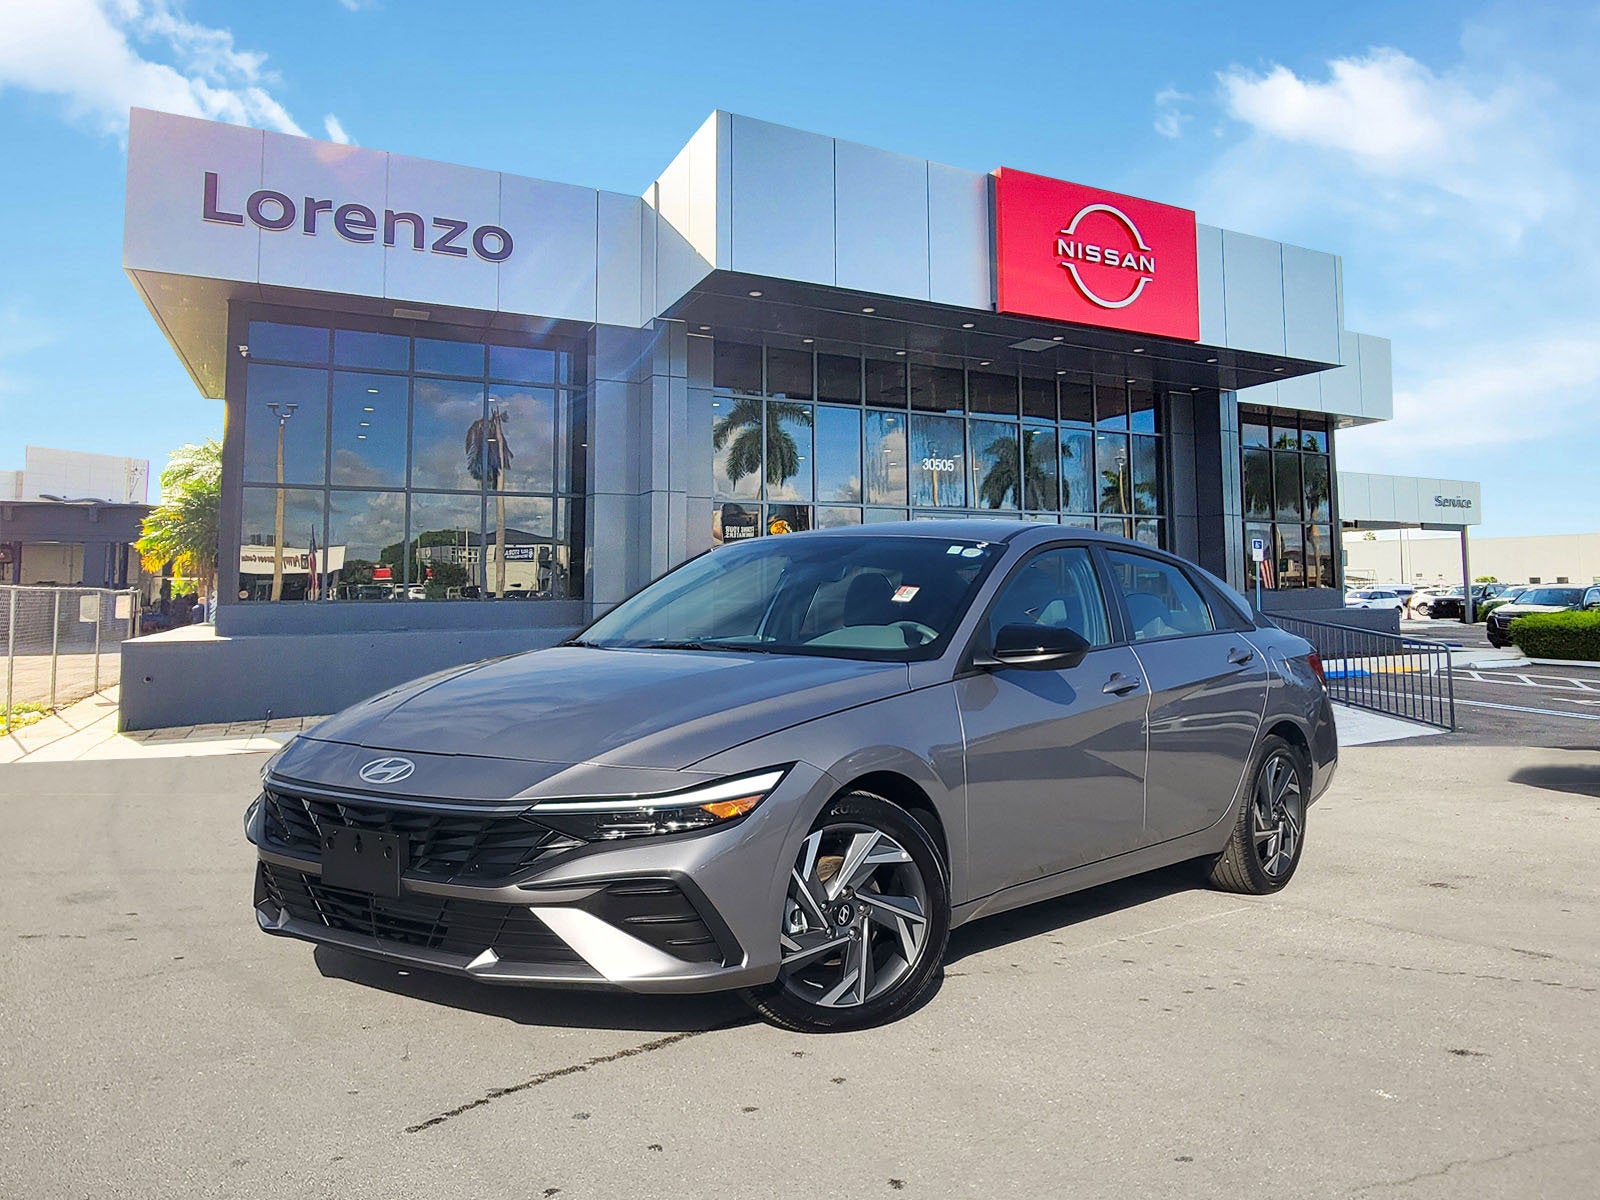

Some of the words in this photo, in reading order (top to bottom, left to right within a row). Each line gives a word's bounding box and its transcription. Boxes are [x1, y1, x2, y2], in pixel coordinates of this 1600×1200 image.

[202, 171, 513, 262] Lorenzo
[1057, 238, 1155, 273] NISSAN
[922, 458, 955, 471] 30505
[1434, 495, 1472, 508] Service
